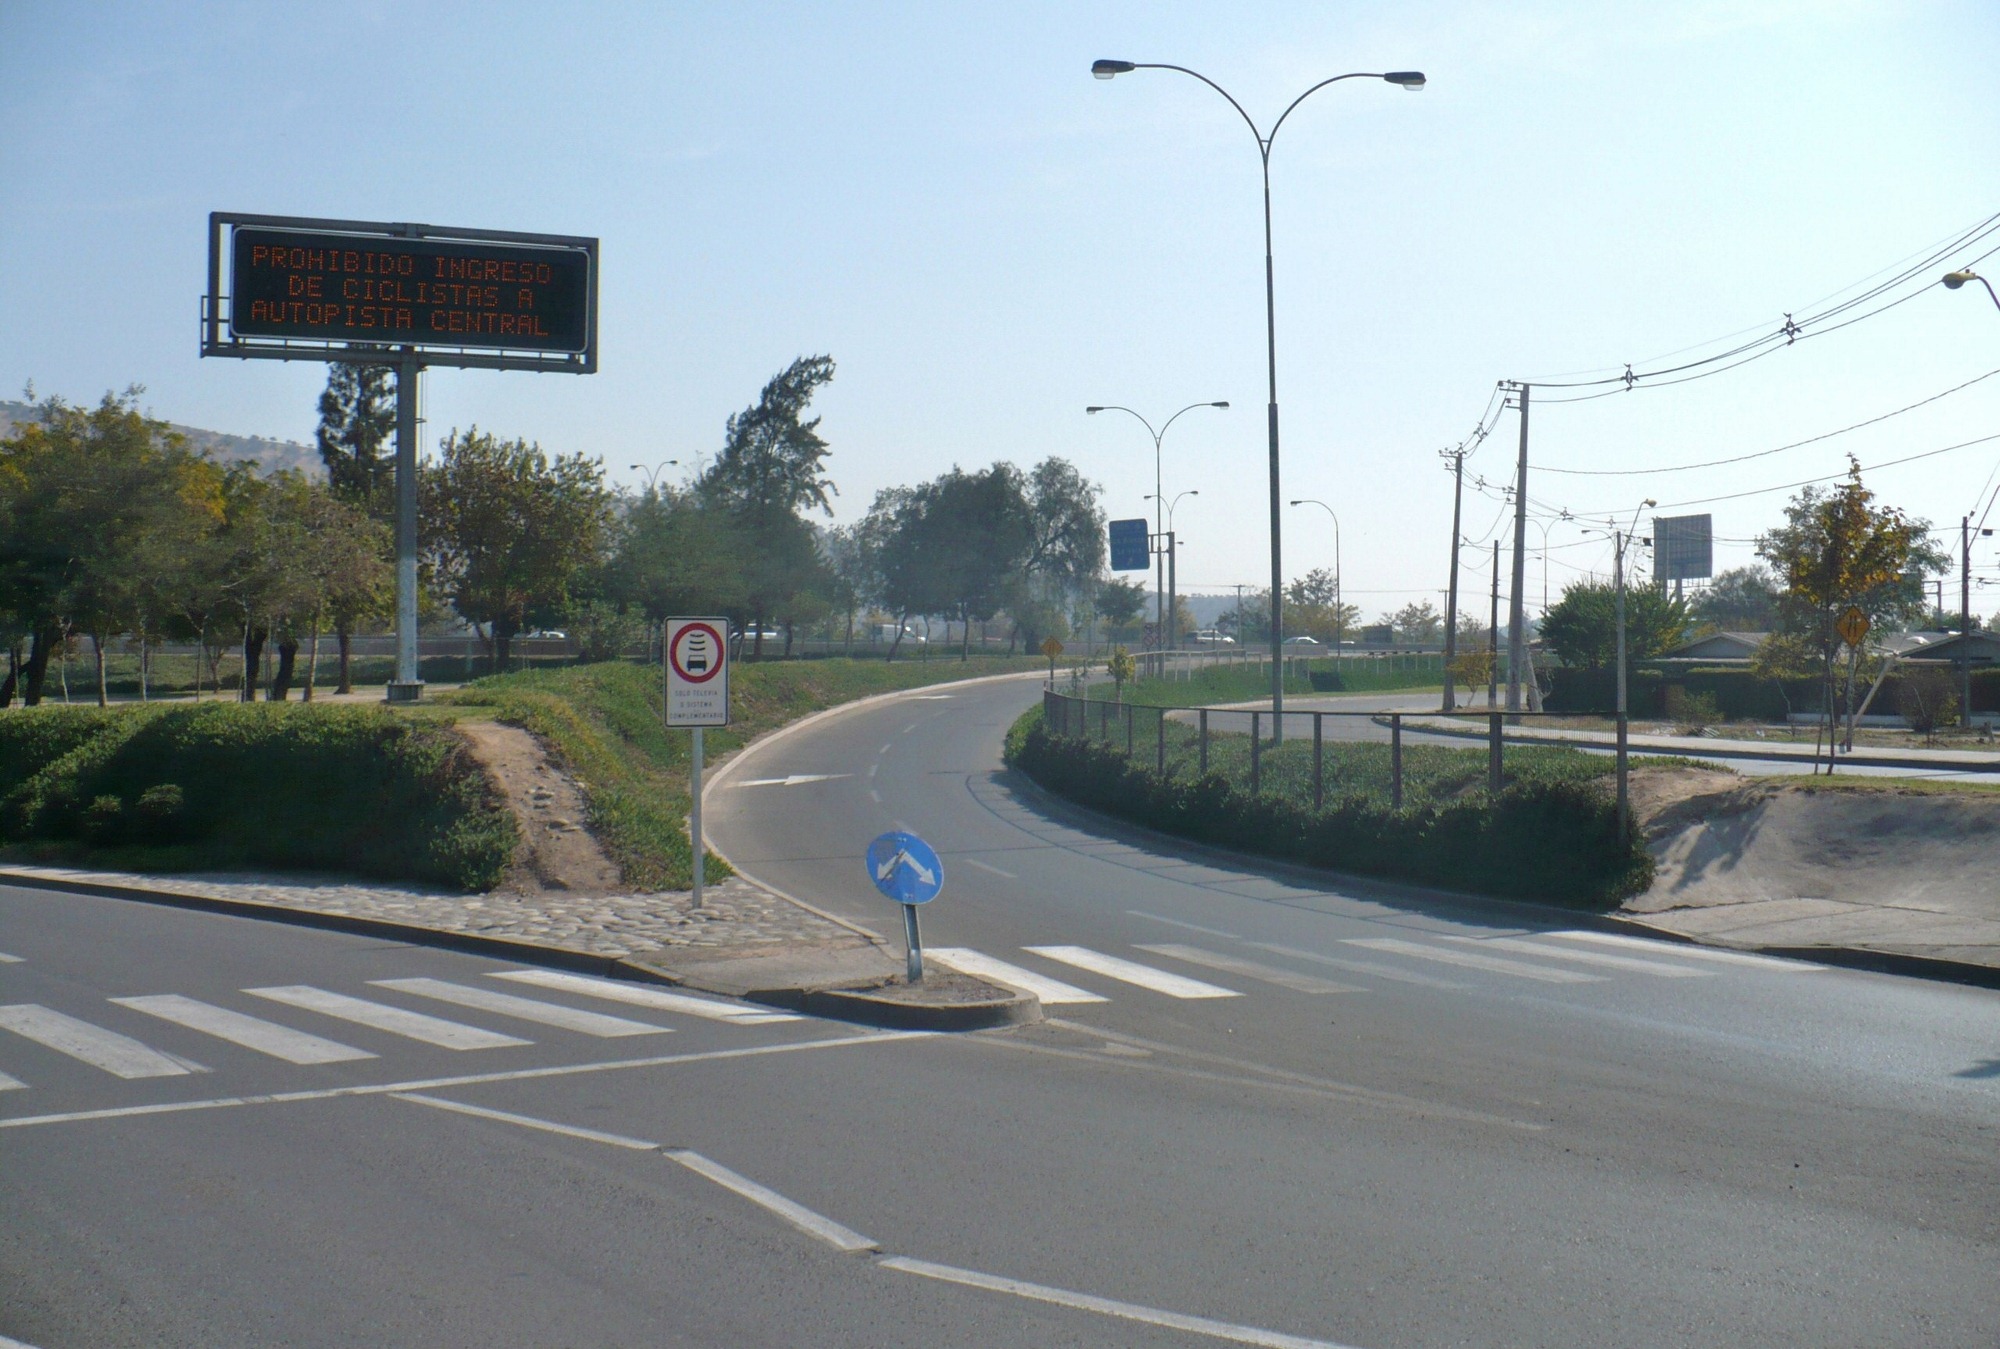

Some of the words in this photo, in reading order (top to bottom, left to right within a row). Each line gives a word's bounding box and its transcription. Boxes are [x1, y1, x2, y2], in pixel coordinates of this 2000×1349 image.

[253, 245, 414, 276] PROHIBIDO
[435, 256, 551, 284] INGRESO
[289, 275, 323, 297] DE
[343, 278, 499, 307] CICLISTAS
[518, 288, 533, 309] A
[251, 300, 413, 329] AUTOPISTA
[431, 309, 549, 336] CENTRAL
